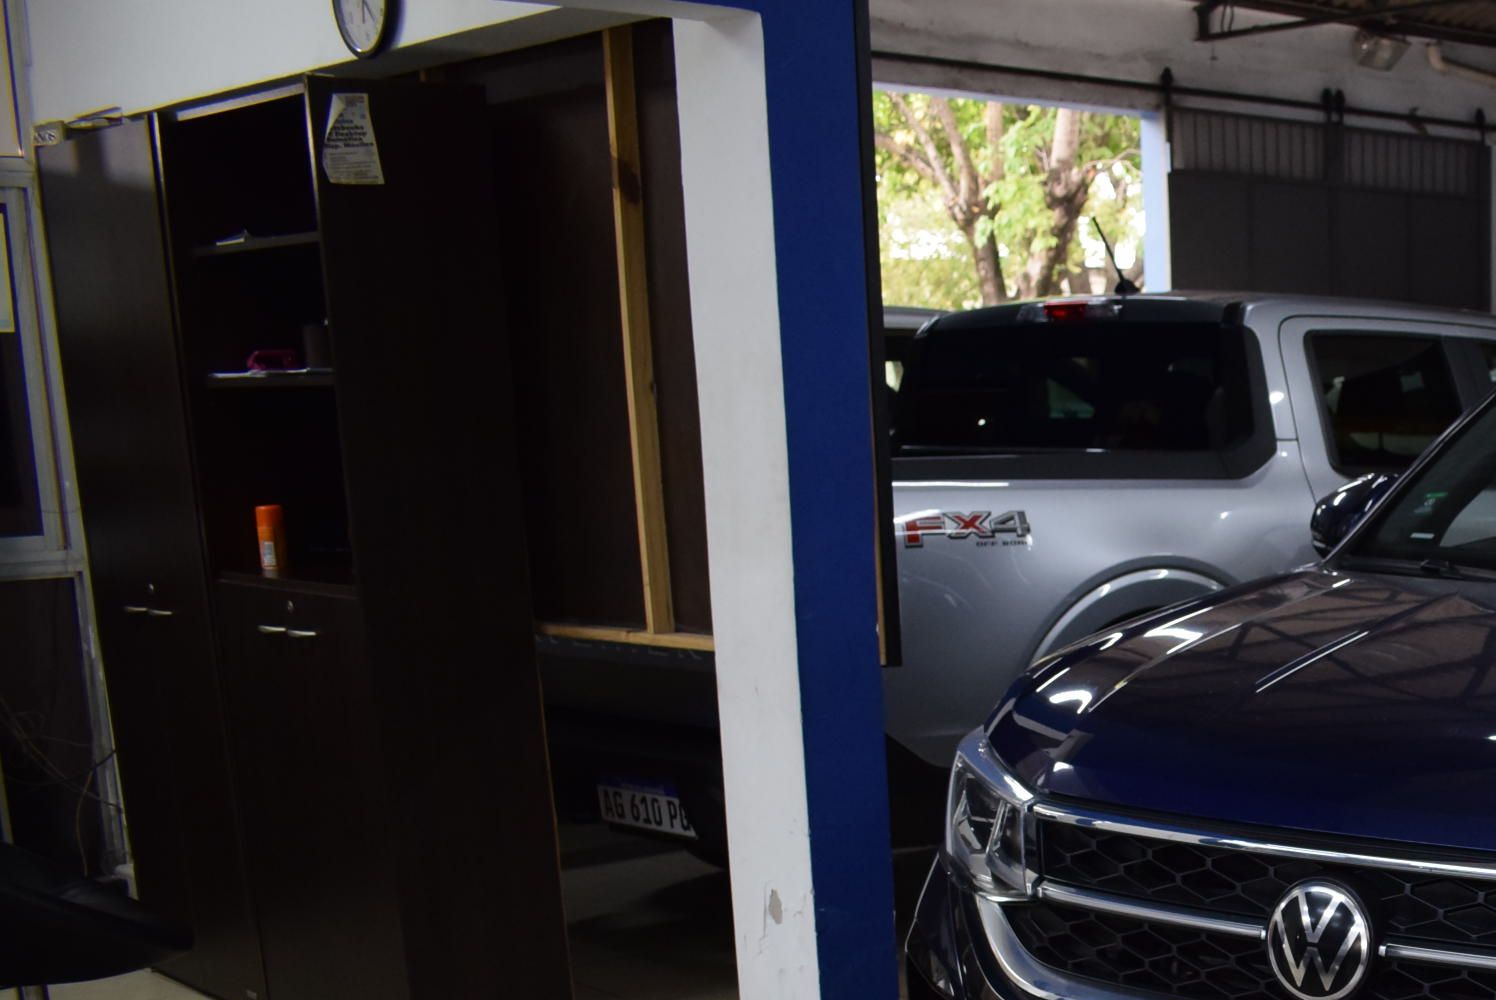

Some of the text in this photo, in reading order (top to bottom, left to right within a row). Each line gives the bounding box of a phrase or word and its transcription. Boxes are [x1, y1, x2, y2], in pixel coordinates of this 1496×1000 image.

[904, 510, 1031, 549] FX4
[603, 789, 626, 819] AG
[631, 793, 663, 827] 610
